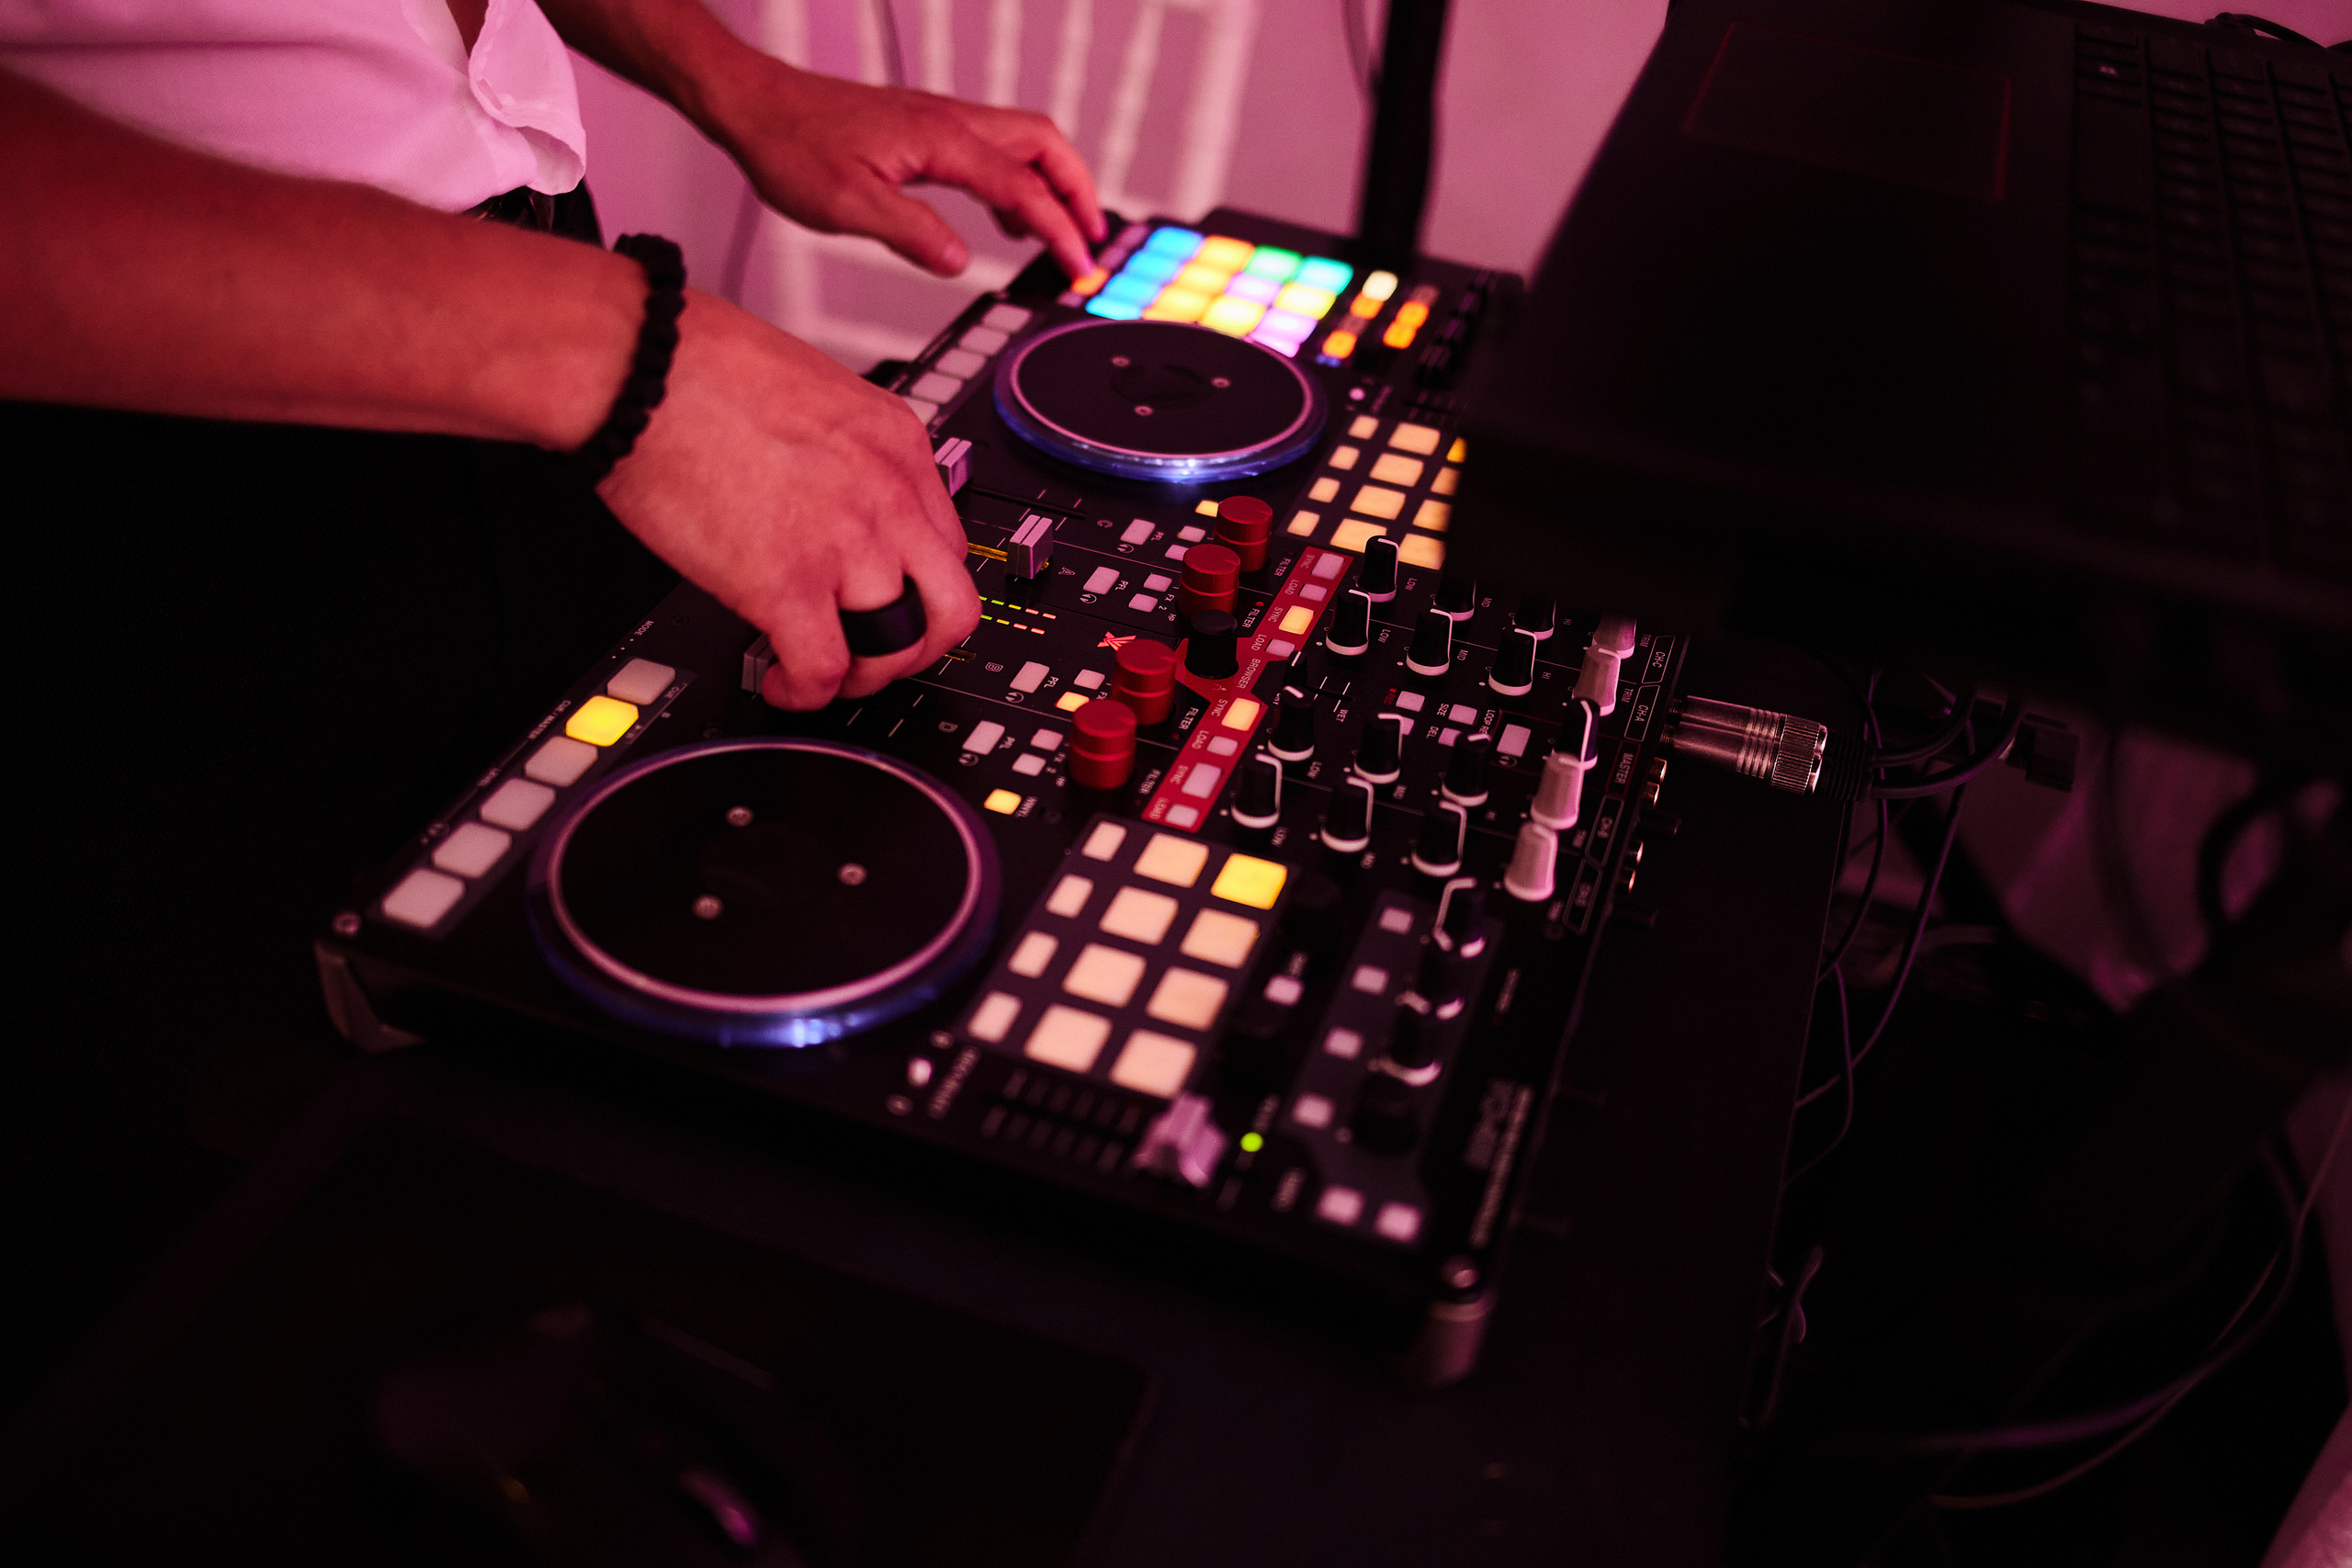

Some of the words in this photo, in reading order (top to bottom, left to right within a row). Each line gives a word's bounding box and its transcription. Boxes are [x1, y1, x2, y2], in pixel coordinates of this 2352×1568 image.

[1273, 558, 1292, 577] FILTER
[1300, 554, 1316, 570] SYNC
[1114, 580, 1129, 591] PFL
[1284, 579, 1300, 595] LOAD
[1405, 578, 1419, 592] LOW
[1164, 592, 1175, 603] FX
[1481, 597, 1492, 608] MID
[1242, 608, 1261, 628] FILTER
[1268, 606, 1283, 623] SYNC
[633, 620, 654, 637] MODE
[1378, 628, 1391, 644] LOW
[1251, 634, 1267, 651] LOAD
[1640, 633, 1651, 648] TRIM
[1456, 649, 1469, 661] MID
[1652, 650, 1666, 669] CH-C
[1237, 658, 1261, 689] BROWSER
[1541, 671, 1552, 680] HI
[1044, 676, 1059, 688] PFL
[1621, 687, 1634, 703] TRIM
[1211, 698, 1228, 717] SYNC
[1437, 703, 1449, 717] SIZE
[1634, 704, 1649, 722] CH-A
[1178, 706, 1199, 730] FILTER
[1335, 709, 1349, 723] WET
[1483, 709, 1496, 726] LOOP
[1426, 726, 1439, 739] DEL
[1614, 752, 1634, 785] MASTER
